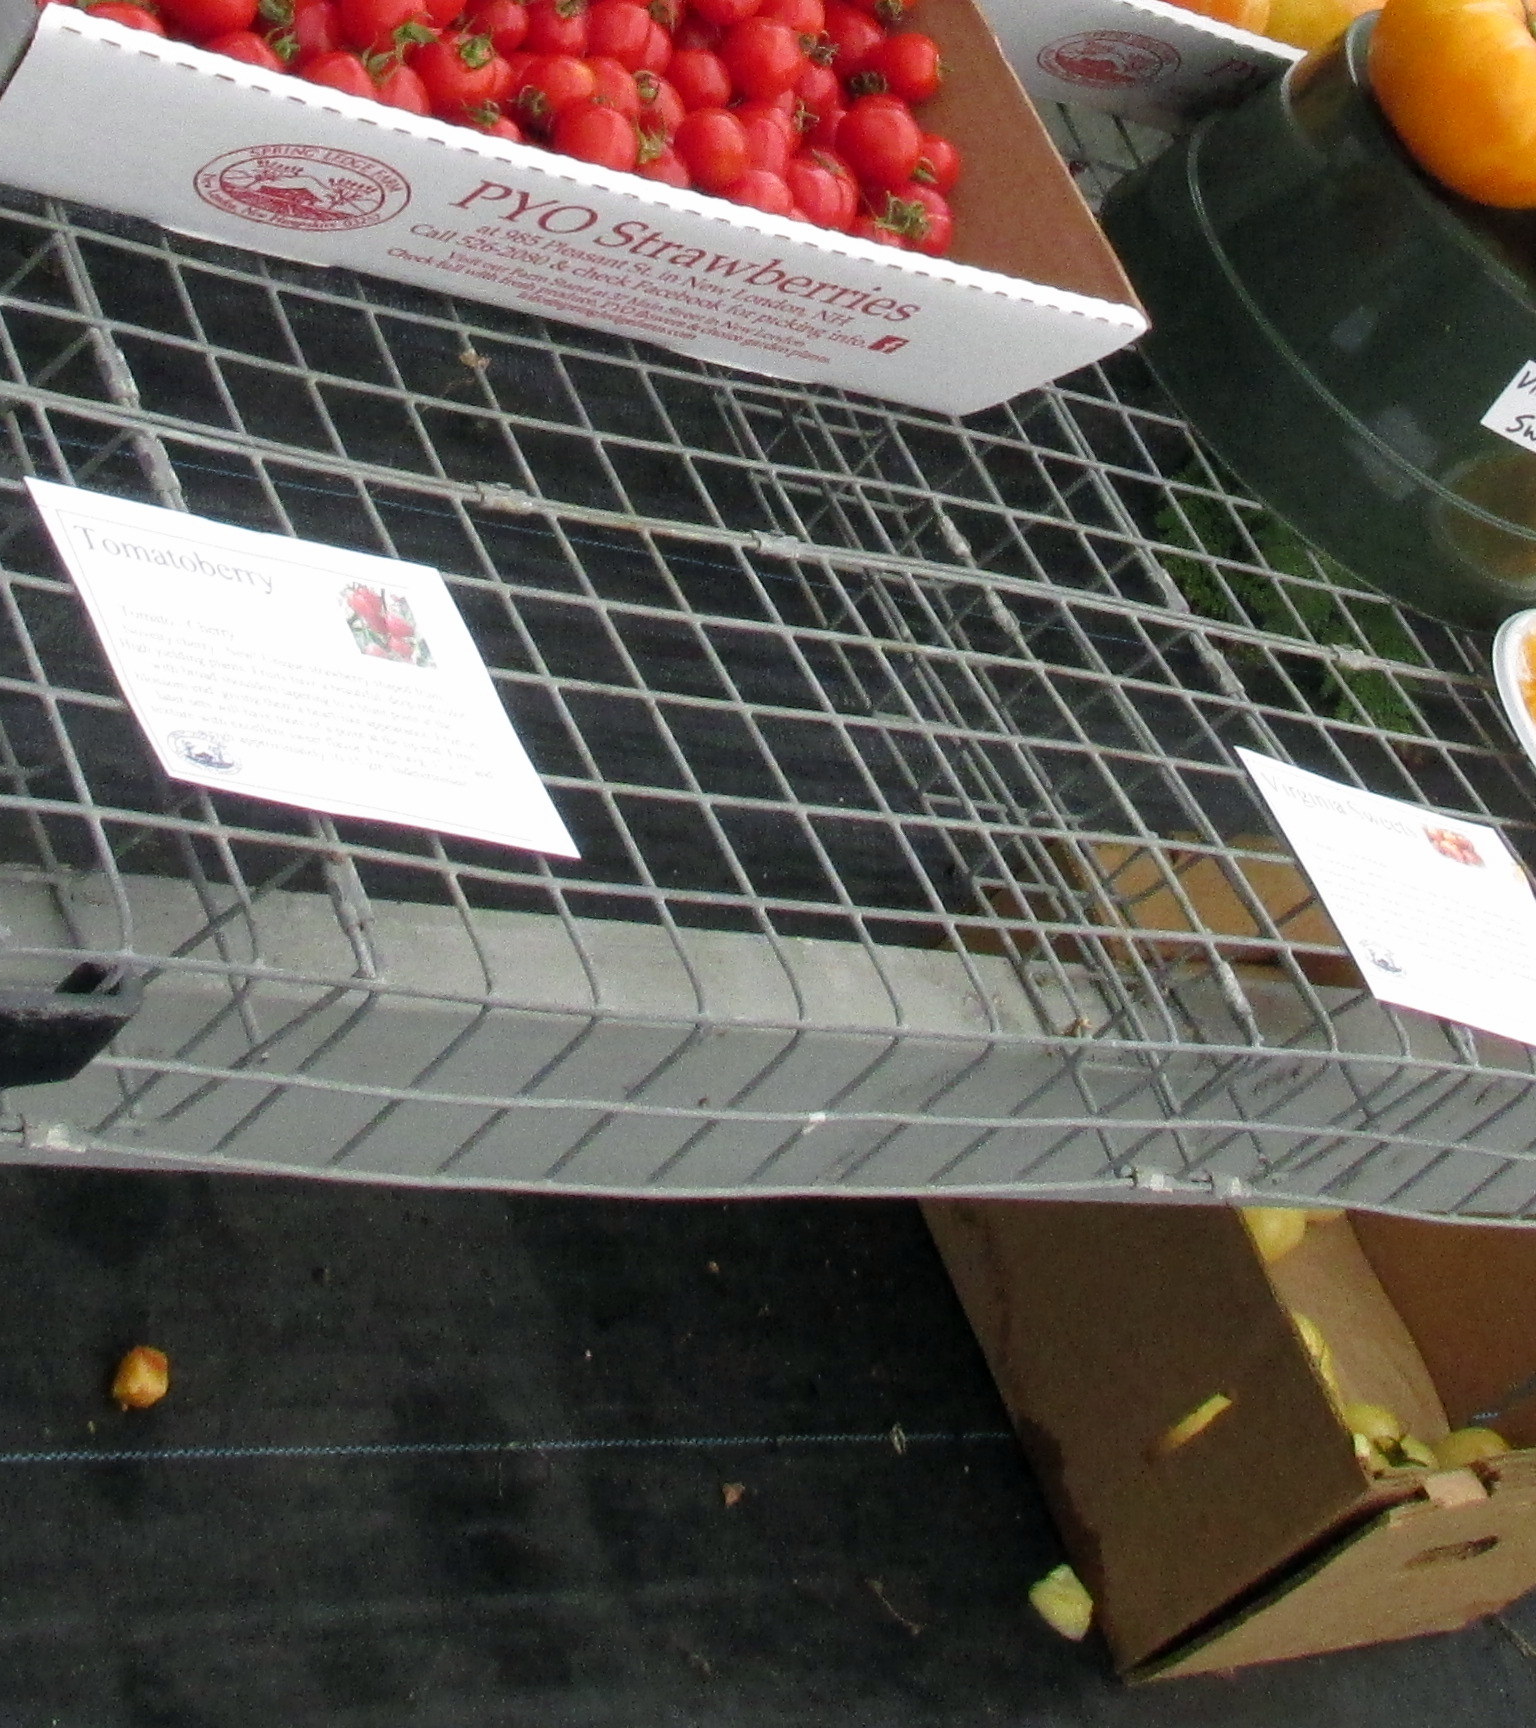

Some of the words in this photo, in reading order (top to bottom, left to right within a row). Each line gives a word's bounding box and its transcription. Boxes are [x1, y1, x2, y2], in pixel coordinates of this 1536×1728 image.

[411, 223, 457, 241] Call
[457, 235, 550, 266] 526-2080
[551, 260, 572, 271] &
[573, 265, 631, 286] check
[633, 279, 724, 310] Facebook
[727, 304, 757, 318] for
[754, 311, 829, 339] picking
[448, 179, 599, 234] PYO
[593, 221, 921, 322] Strawberries
[478, 224, 500, 235] at
[505, 231, 542, 246] 985
[543, 240, 628, 268] Pleasant
[658, 271, 680, 281] in
[684, 277, 732, 295] New
[813, 310, 854, 326] NH
[74, 524, 275, 595] Tomatoberry
